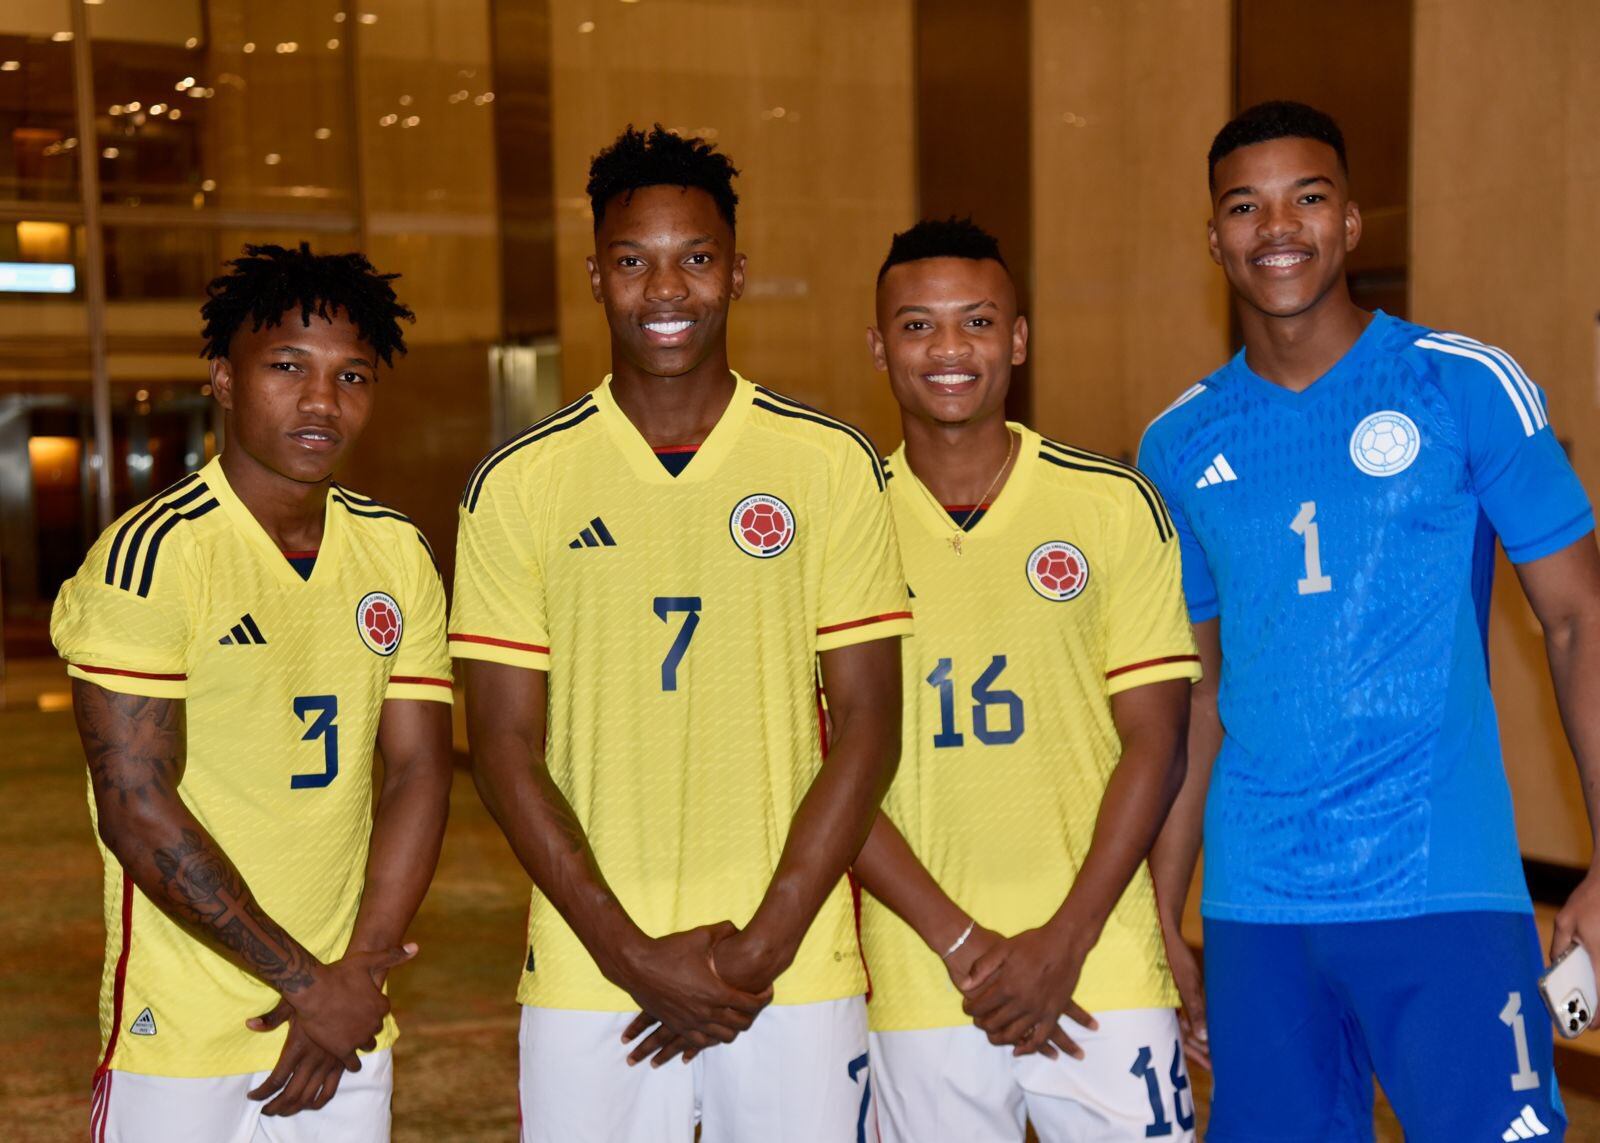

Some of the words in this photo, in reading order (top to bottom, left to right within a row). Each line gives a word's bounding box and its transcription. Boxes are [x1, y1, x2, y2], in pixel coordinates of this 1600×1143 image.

[1289, 500, 1332, 595] 1
[653, 596, 702, 692] 7
[290, 694, 339, 789] 3
[926, 655, 1025, 748] 16
[1499, 991, 1540, 1092] 1
